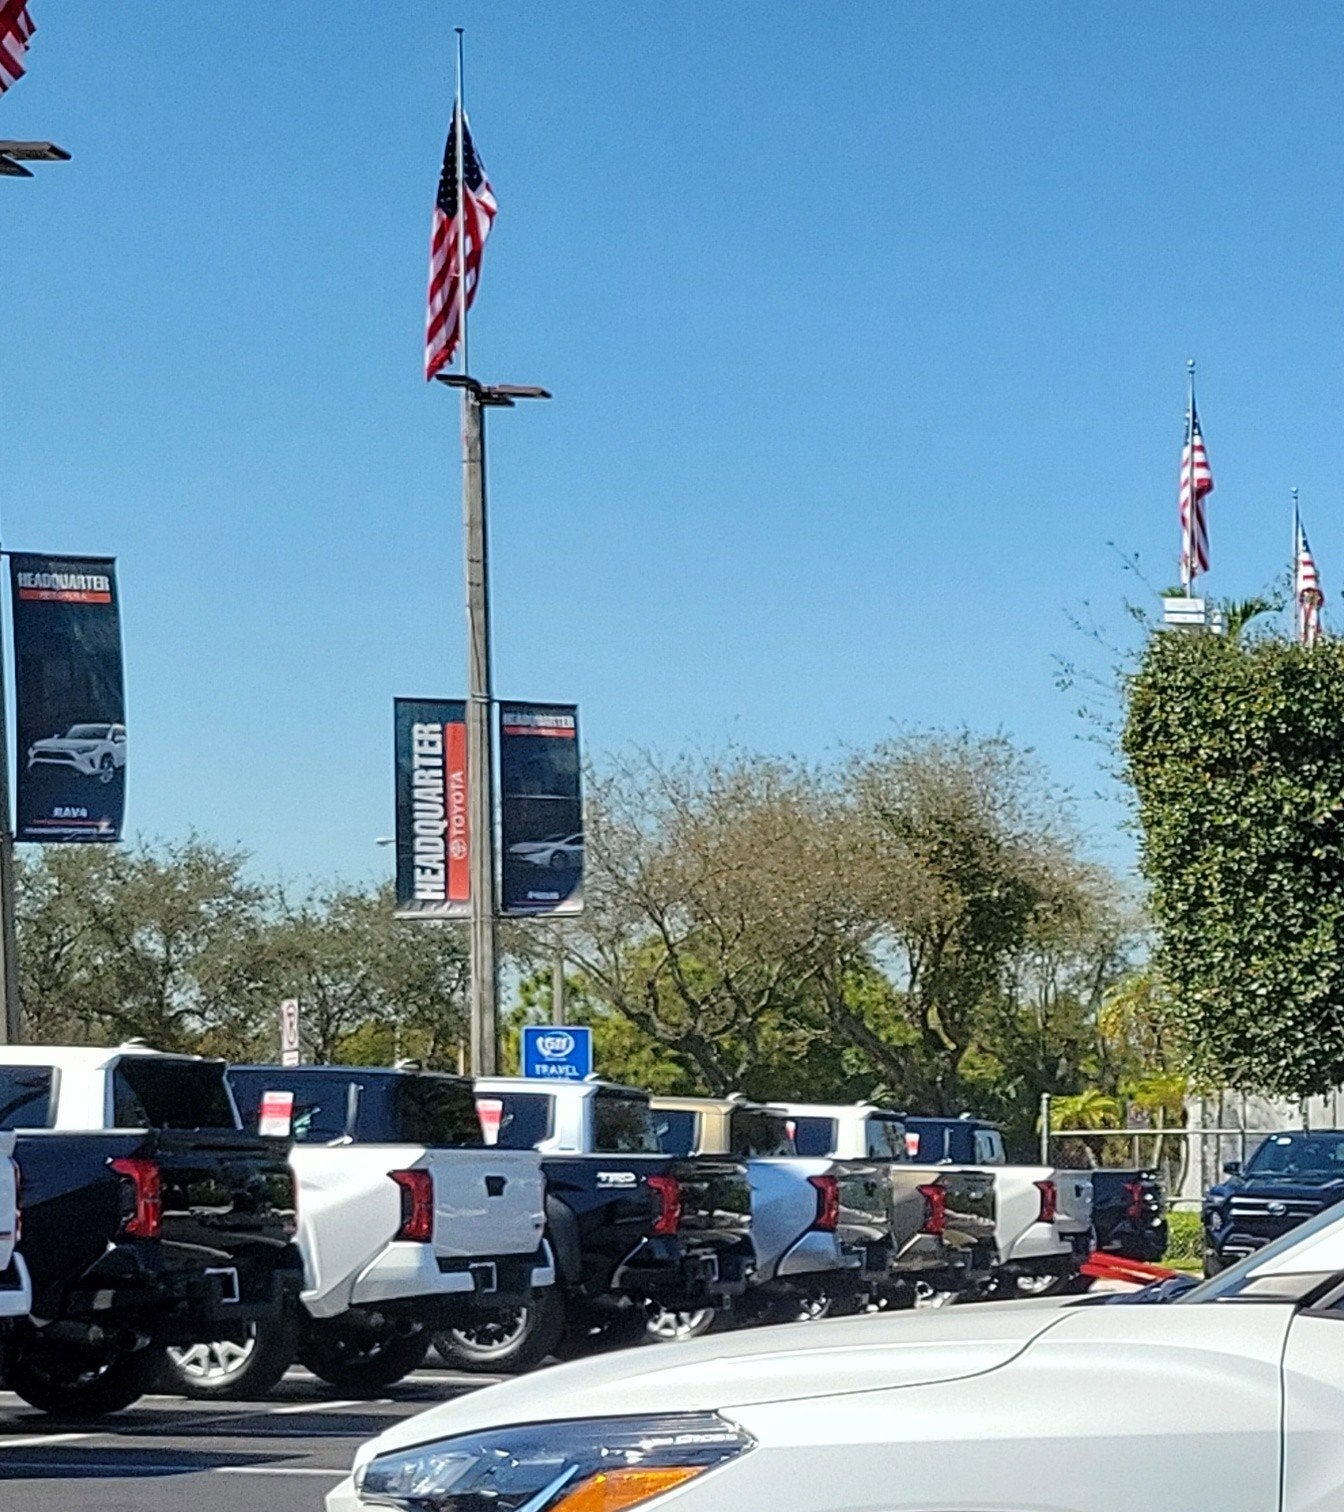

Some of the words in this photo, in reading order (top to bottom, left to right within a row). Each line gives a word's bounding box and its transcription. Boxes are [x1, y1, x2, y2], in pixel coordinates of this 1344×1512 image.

[18, 572, 110, 592] HEADQUARTER
[412, 722, 448, 899] HEADQUARTER
[450, 771, 465, 836] TOYOTA
[534, 1064, 580, 1076] TRAVEL
